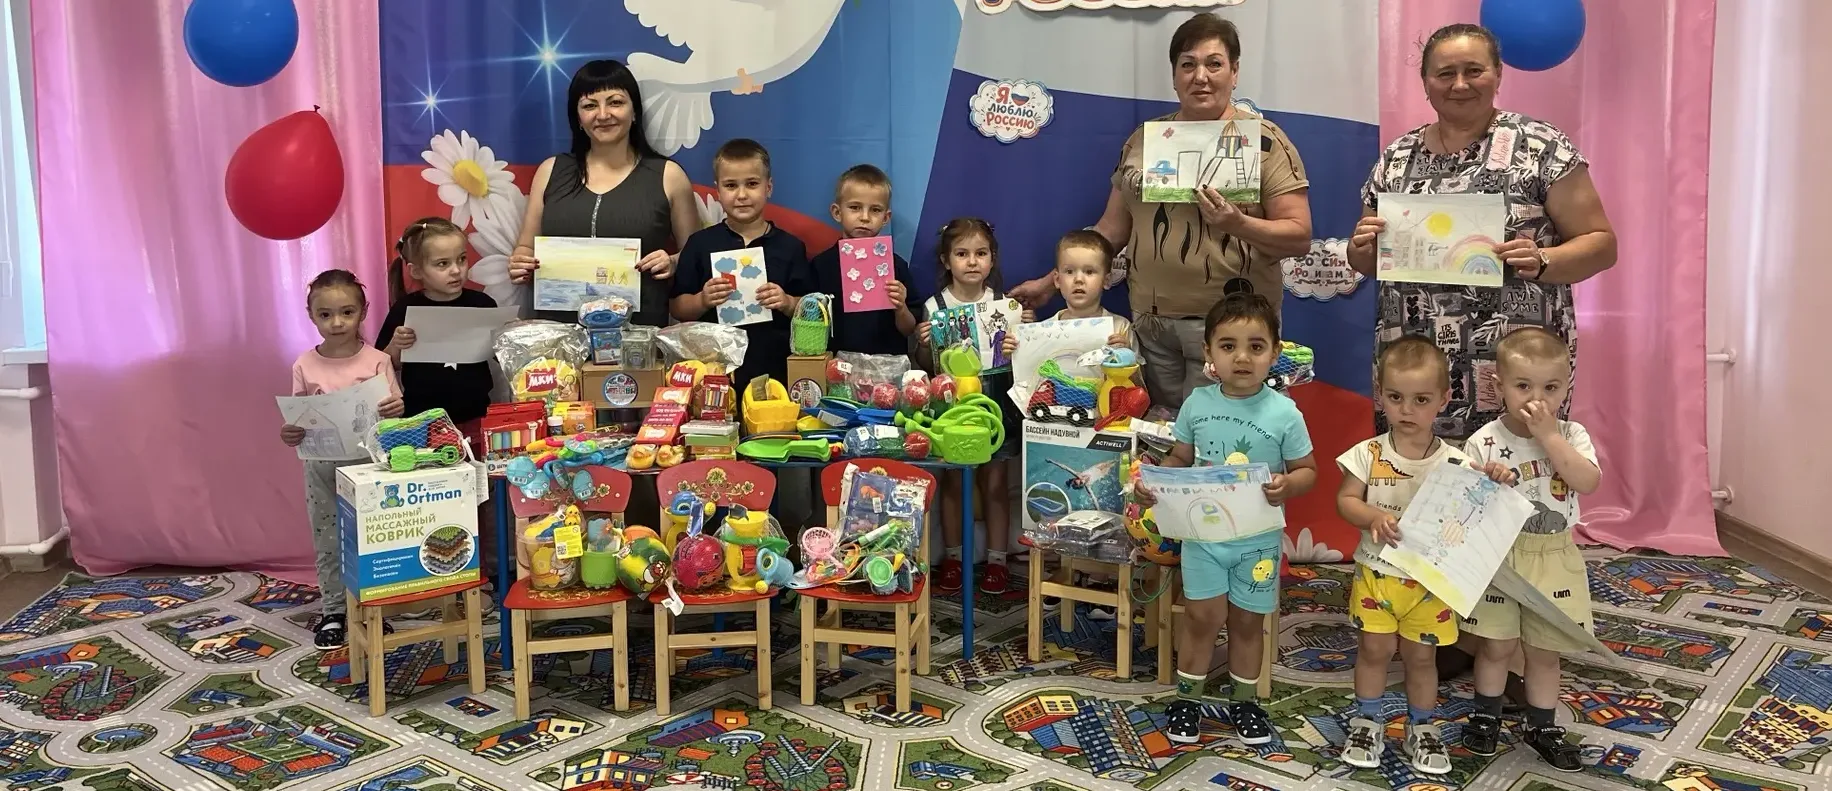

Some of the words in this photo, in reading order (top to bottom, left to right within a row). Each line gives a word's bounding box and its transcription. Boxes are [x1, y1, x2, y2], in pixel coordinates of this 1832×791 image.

[995, 86, 1010, 104] Я
[1025, 425, 1050, 435] БАССЕЙН
[1050, 429, 1080, 439] НАДУВНОЙ
[1232, 417, 1245, 426] my
[1247, 420, 1272, 440] friend
[407, 482, 427, 493] Dr.
[407, 489, 462, 505] Ortman
[365, 507, 423, 523] НАПОЛЬНЫЙ
[365, 513, 436, 532] МАССАЖНЫЙ
[366, 526, 425, 545] КОВРИК
